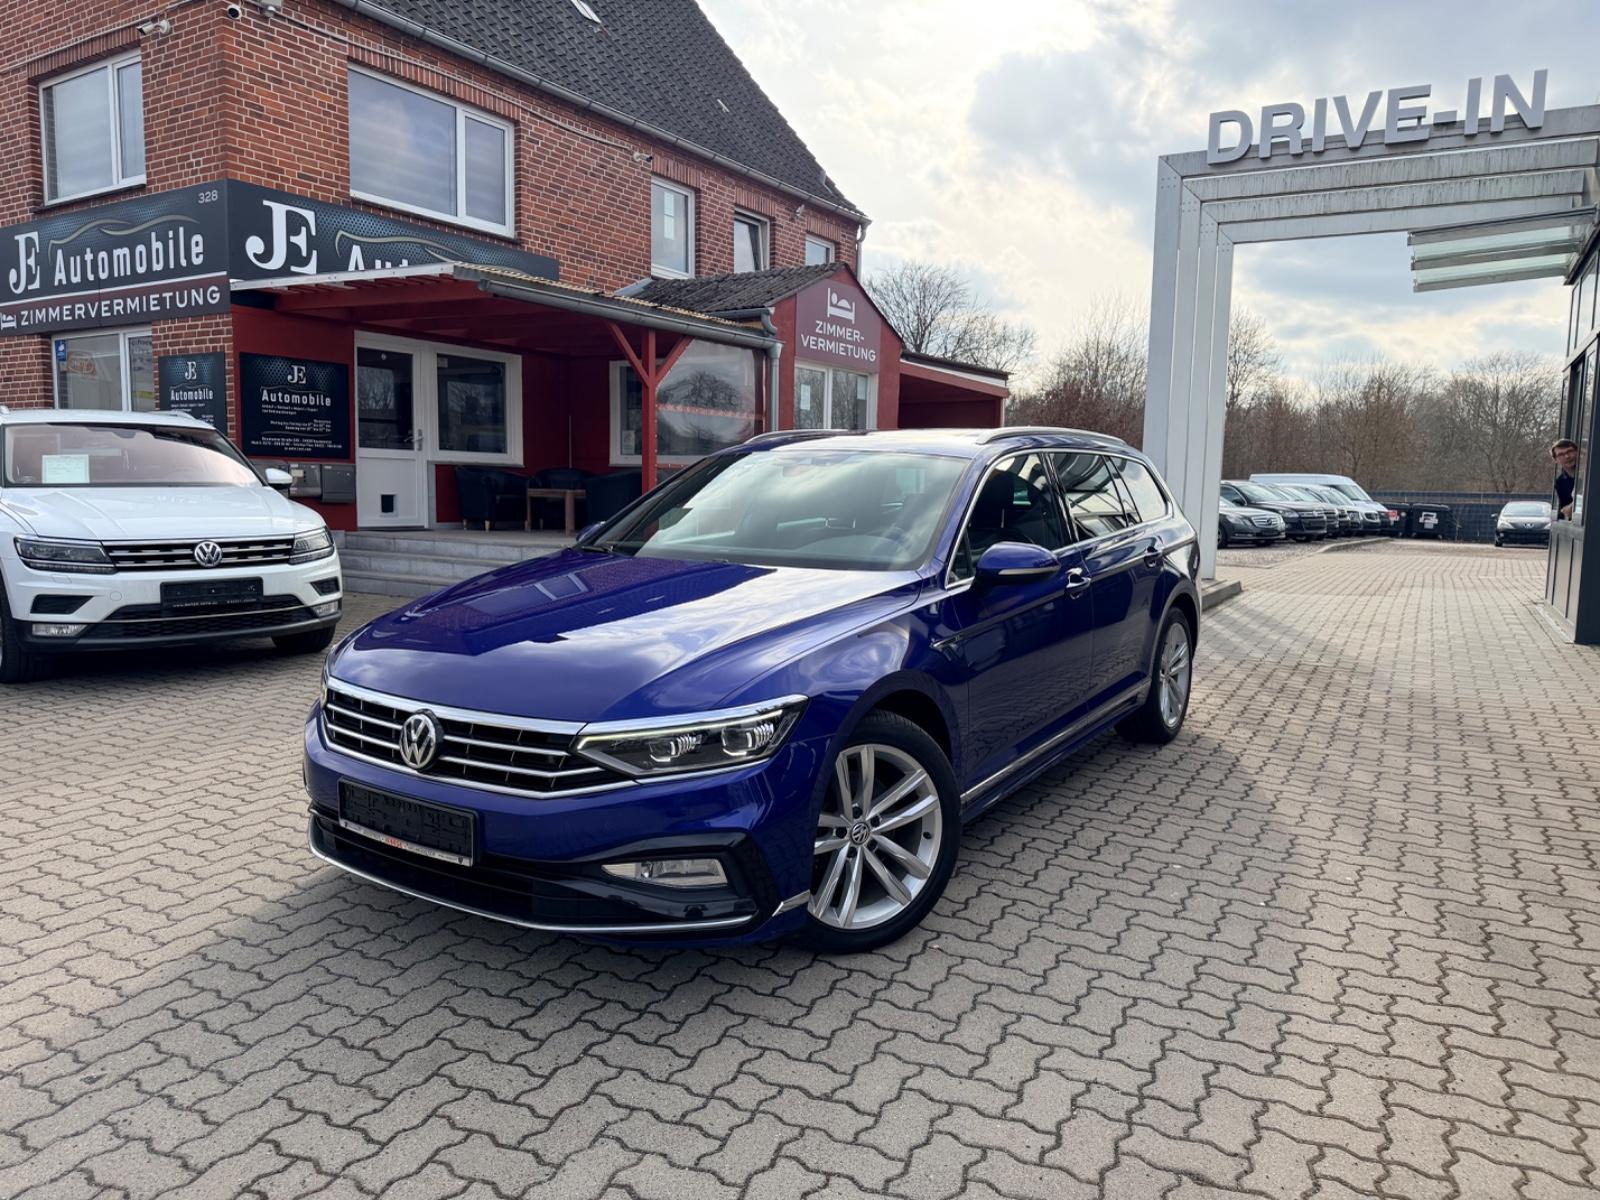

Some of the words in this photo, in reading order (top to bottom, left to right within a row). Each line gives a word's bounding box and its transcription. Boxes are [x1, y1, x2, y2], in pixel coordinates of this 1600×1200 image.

[1206, 69, 1549, 165] DRIVE-IN
[198, 189, 219, 204] 328
[244, 199, 318, 275] JE
[8, 231, 41, 295] JE
[54, 226, 205, 286] Automobile
[20, 285, 221, 327] ZIMMERVERMIETUNG
[801, 334, 876, 362] VERMIETUNG
[815, 320, 865, 343] ZIMMER-
[170, 388, 214, 401] Automobile
[261, 389, 332, 407] Automobile
[400, 713, 436, 769] VW
